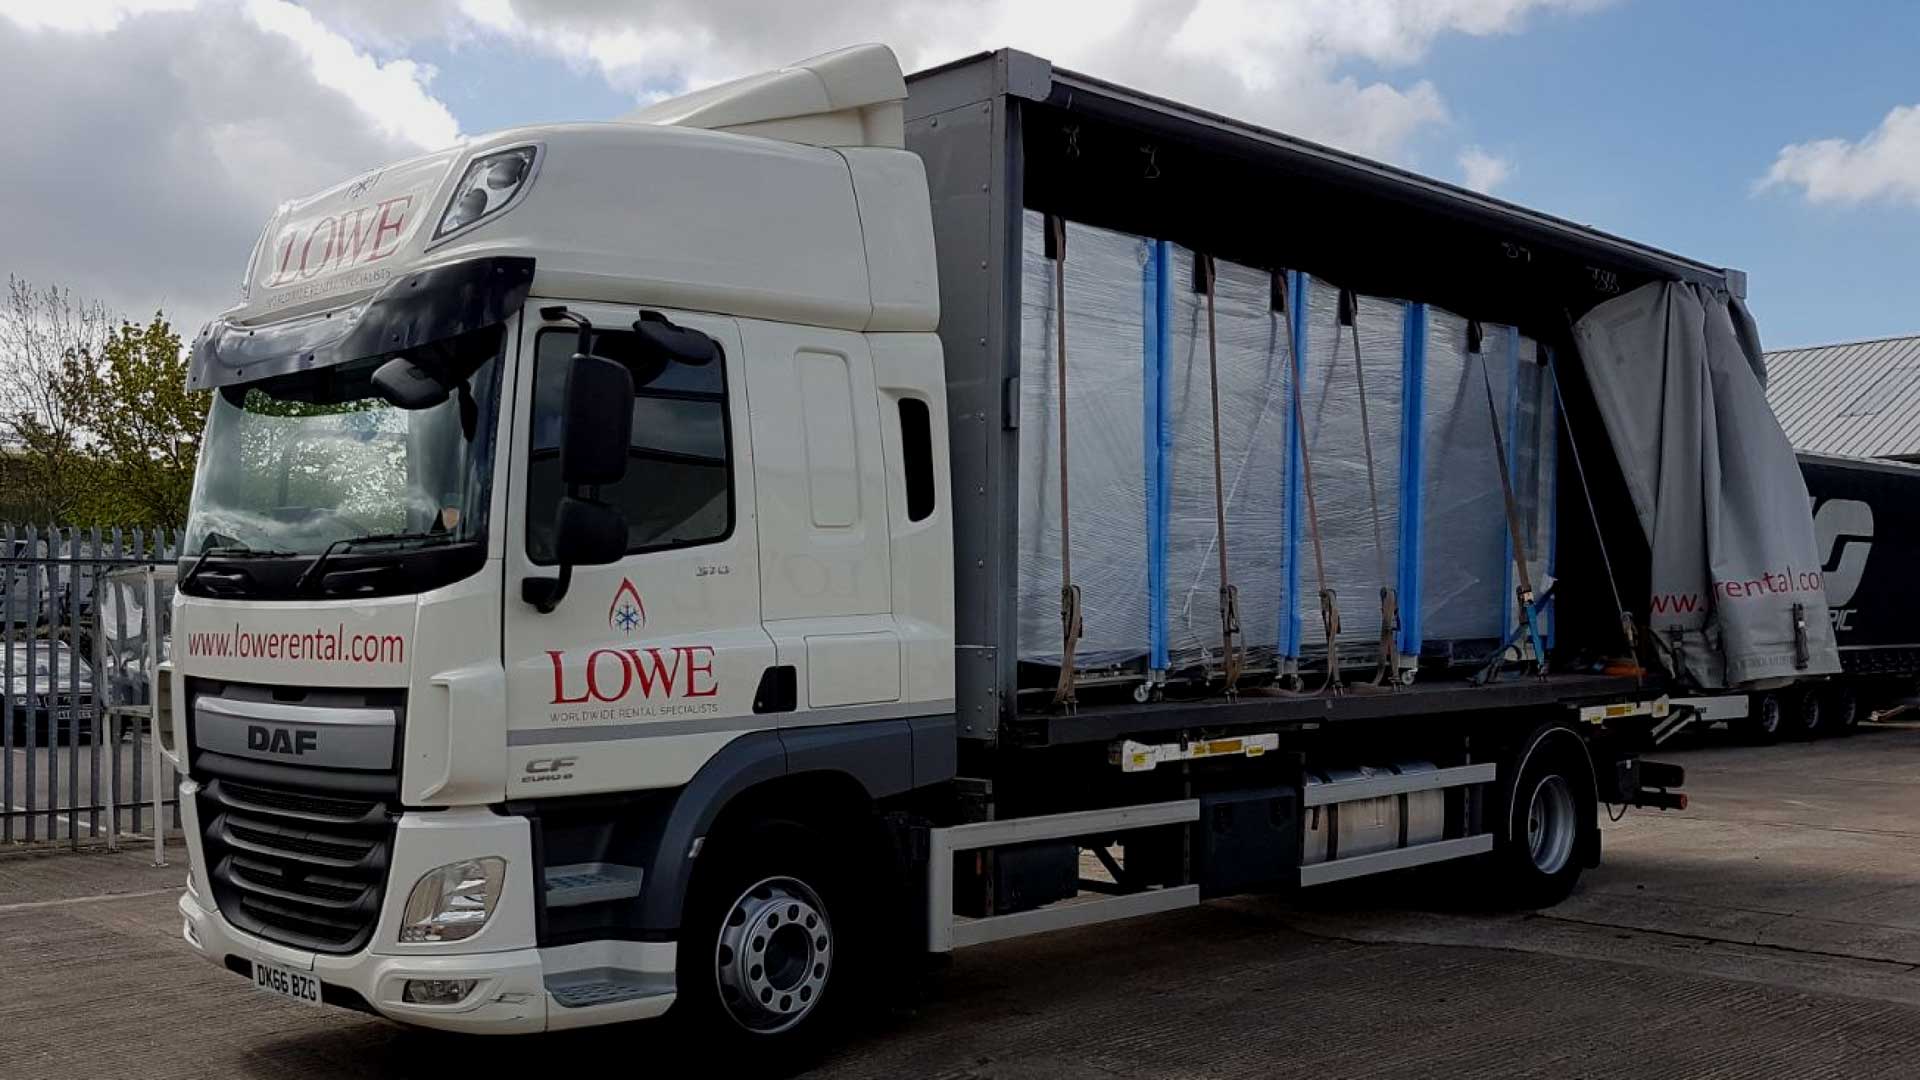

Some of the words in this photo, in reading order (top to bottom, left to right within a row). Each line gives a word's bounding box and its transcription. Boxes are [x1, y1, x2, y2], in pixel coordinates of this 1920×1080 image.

[267, 195, 414, 289] LOWE
[187, 622, 404, 664] www.lowerental.com
[545, 645, 719, 704] LOWE
[550, 709, 616, 723] WORLDWIDE
[619, 706, 657, 718] RENTAL
[660, 703, 719, 716] SPECIALISTS
[247, 725, 318, 756] DAF
[526, 756, 580, 773] CF
[257, 964, 290, 993] DK66
[292, 975, 317, 1001] BZG
